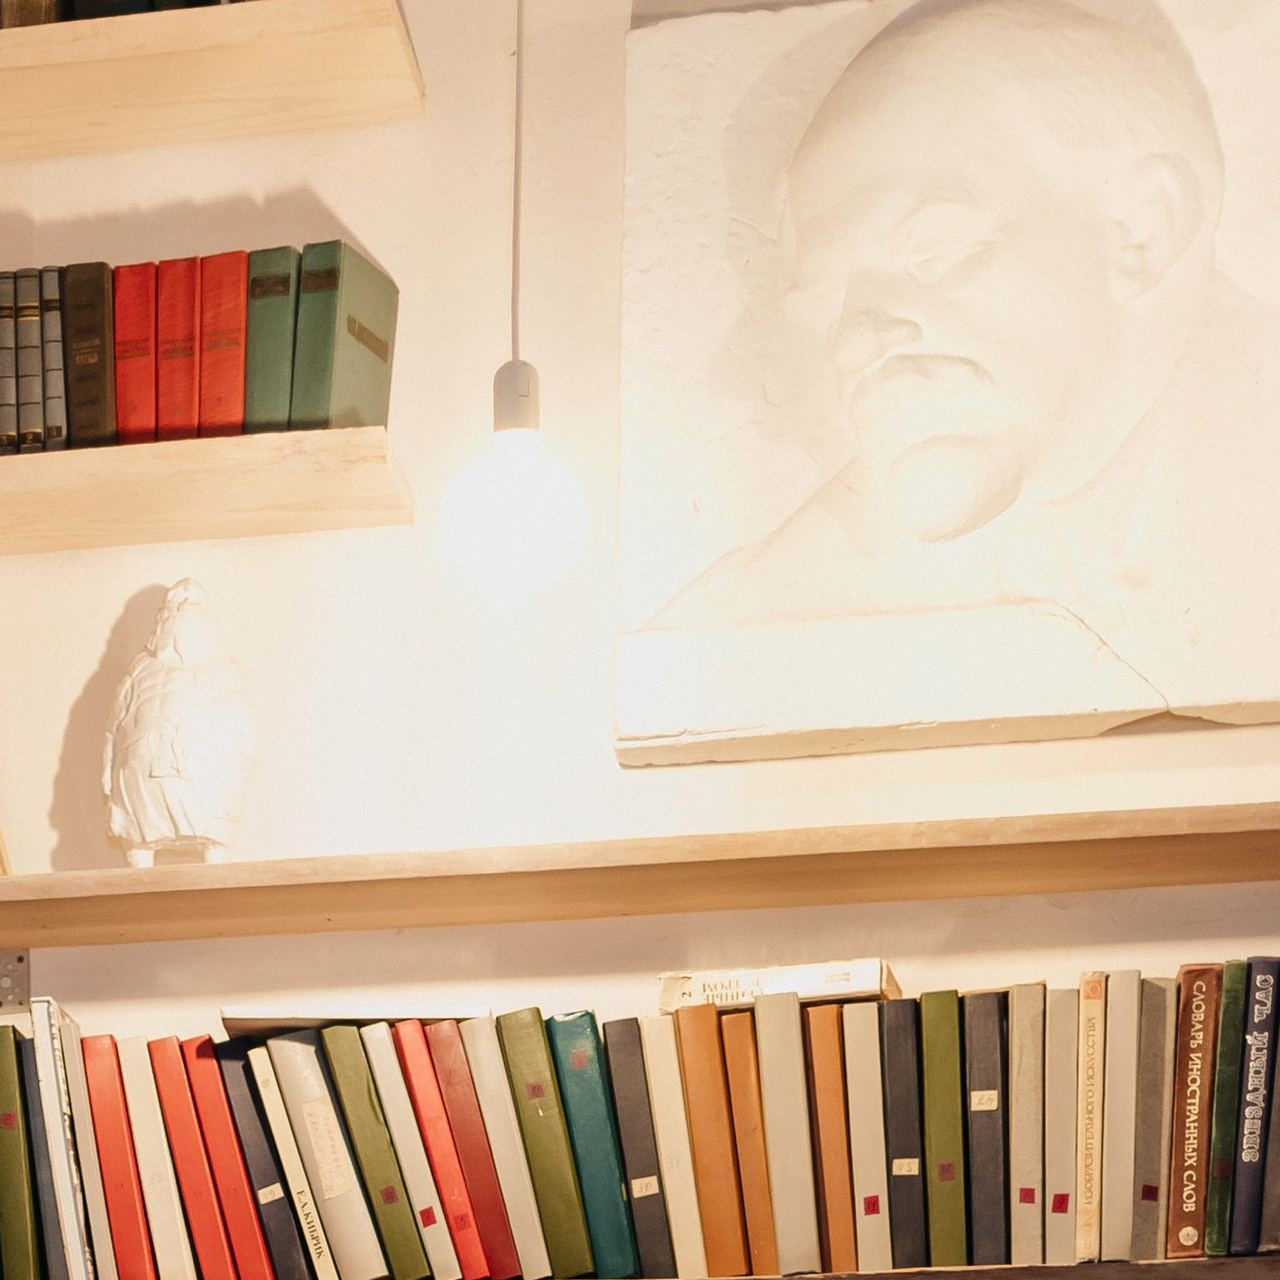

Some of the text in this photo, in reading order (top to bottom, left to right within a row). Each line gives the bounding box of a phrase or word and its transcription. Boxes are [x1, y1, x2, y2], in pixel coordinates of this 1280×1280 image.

[1083, 1016, 1097, 1206] ИЗОБРАЗИТЕЛЬНОГО ИСКУССТВА
[1182, 981, 1208, 1213] СЛОВАРЬ ИНОСТРАННЫХ СЛОВ
[1242, 974, 1275, 1164] ЗВЕЗДНЫЙ ЧАС
